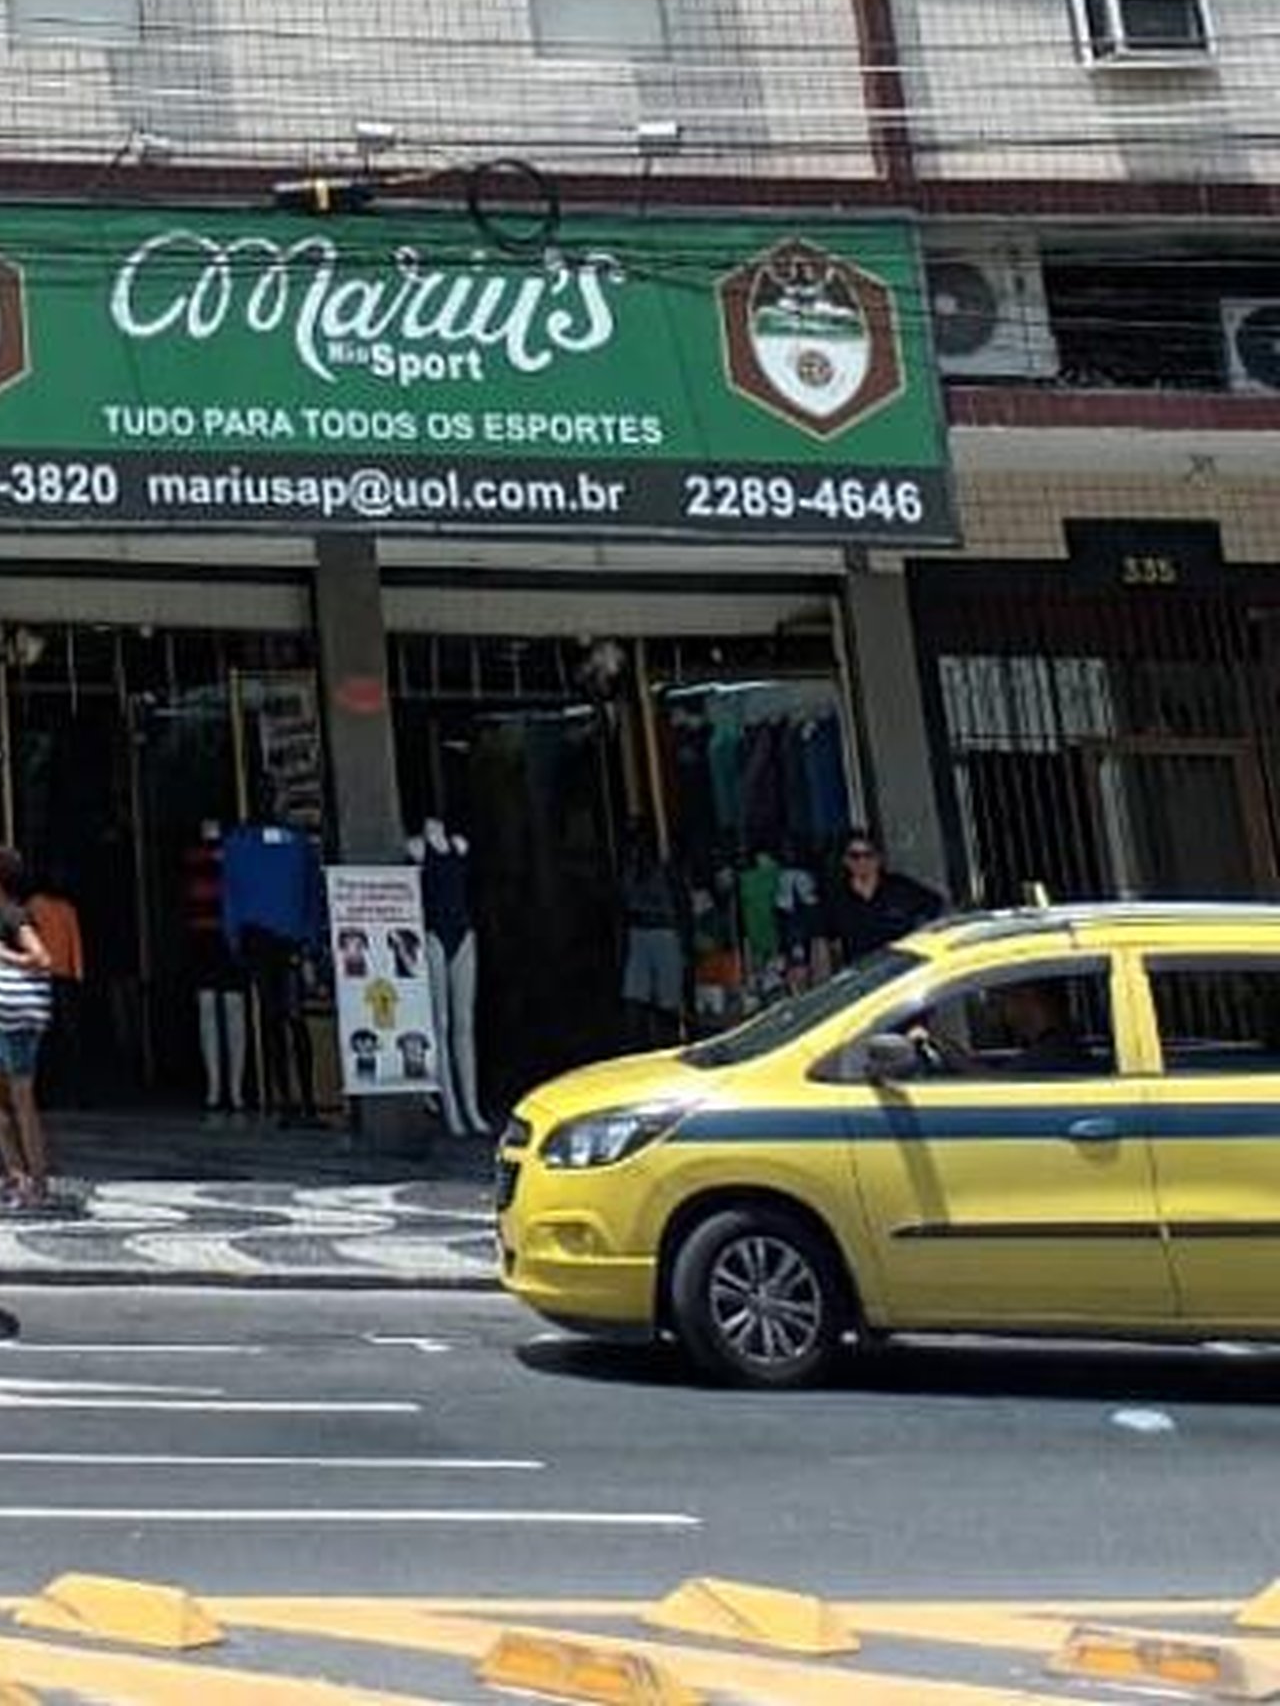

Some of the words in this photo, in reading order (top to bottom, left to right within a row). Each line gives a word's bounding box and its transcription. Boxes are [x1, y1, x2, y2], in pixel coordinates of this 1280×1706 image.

[371, 343, 483, 386] Sport
[104, 405, 194, 436] TUDO
[202, 407, 295, 438] PARA
[301, 409, 418, 440] TODOS
[427, 411, 474, 440] OS
[483, 412, 663, 444] ESPORTES
[146, 467, 626, 516] mariusap@uol.com.br
[685, 475, 923, 523] 2289-4646
